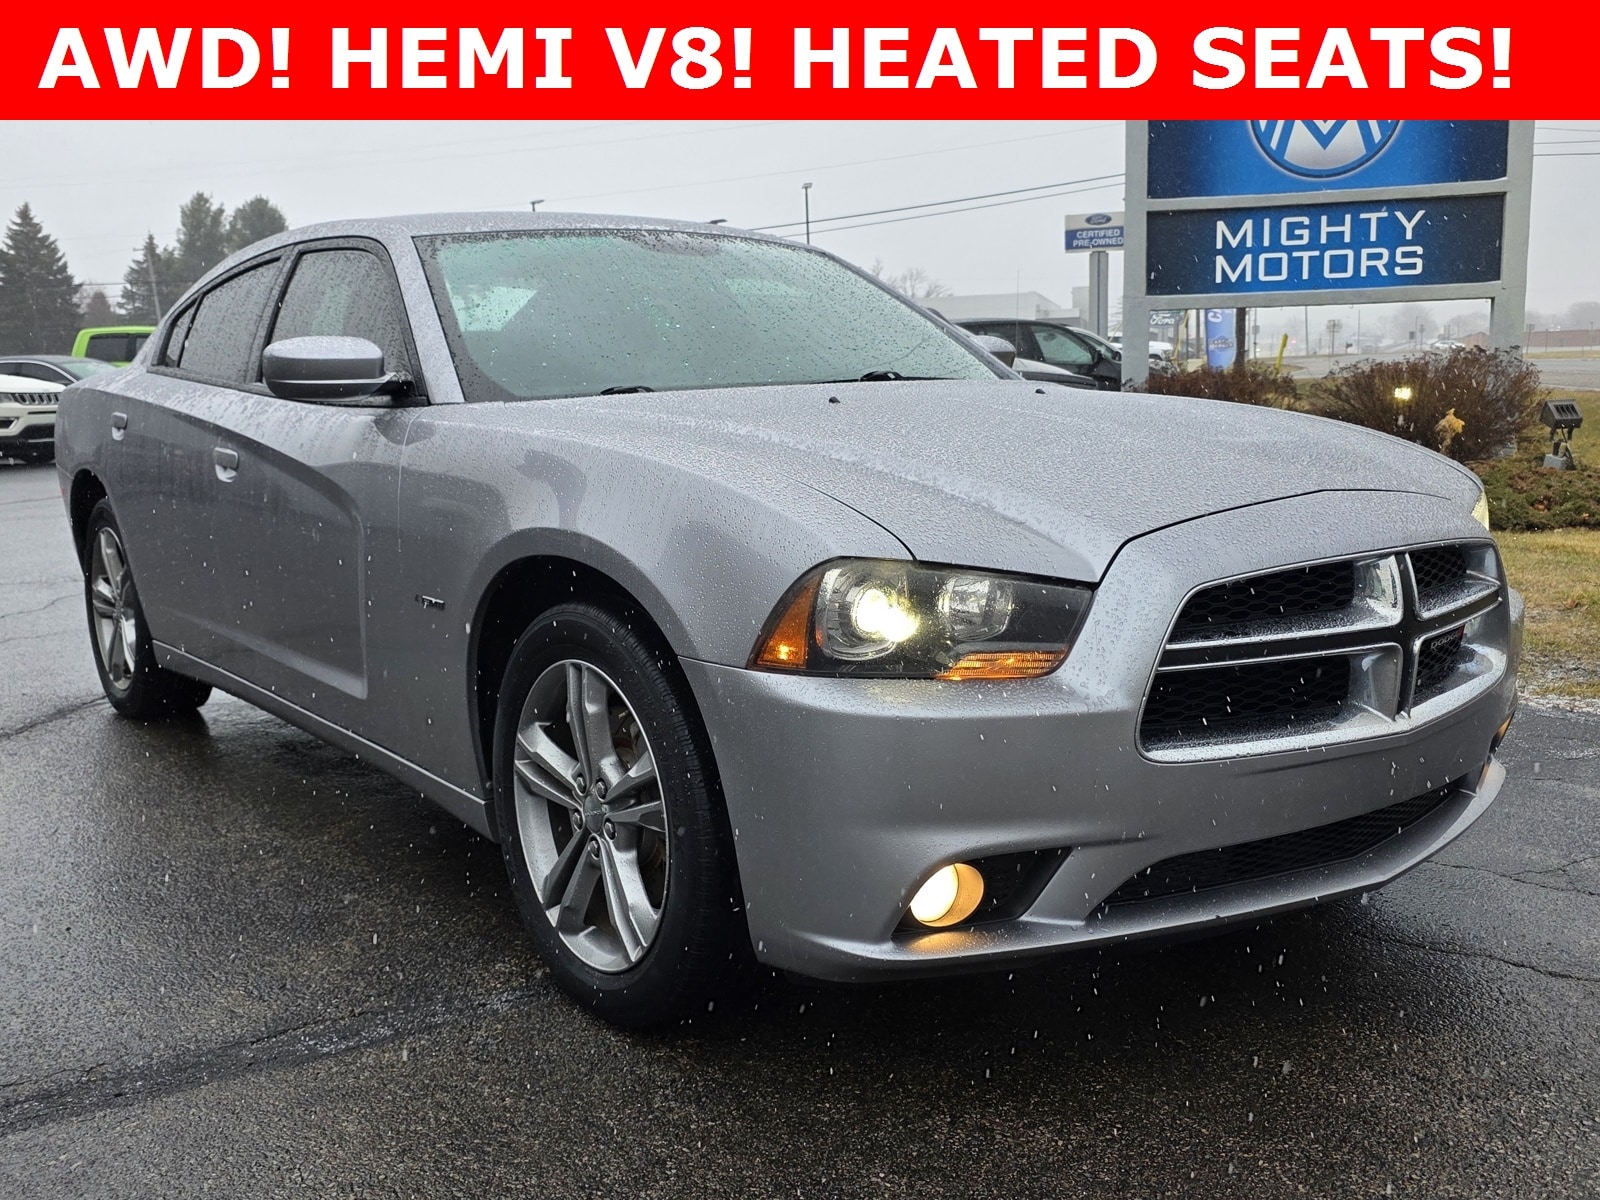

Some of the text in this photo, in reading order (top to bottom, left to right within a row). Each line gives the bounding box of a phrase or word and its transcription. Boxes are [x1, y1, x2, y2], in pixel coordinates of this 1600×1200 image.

[1076, 229, 1120, 239] CERTIFIED
[1216, 210, 1425, 249] MIGHTY
[1072, 237, 1123, 247] PRE-OWNED
[1215, 245, 1423, 283] MOTORS
